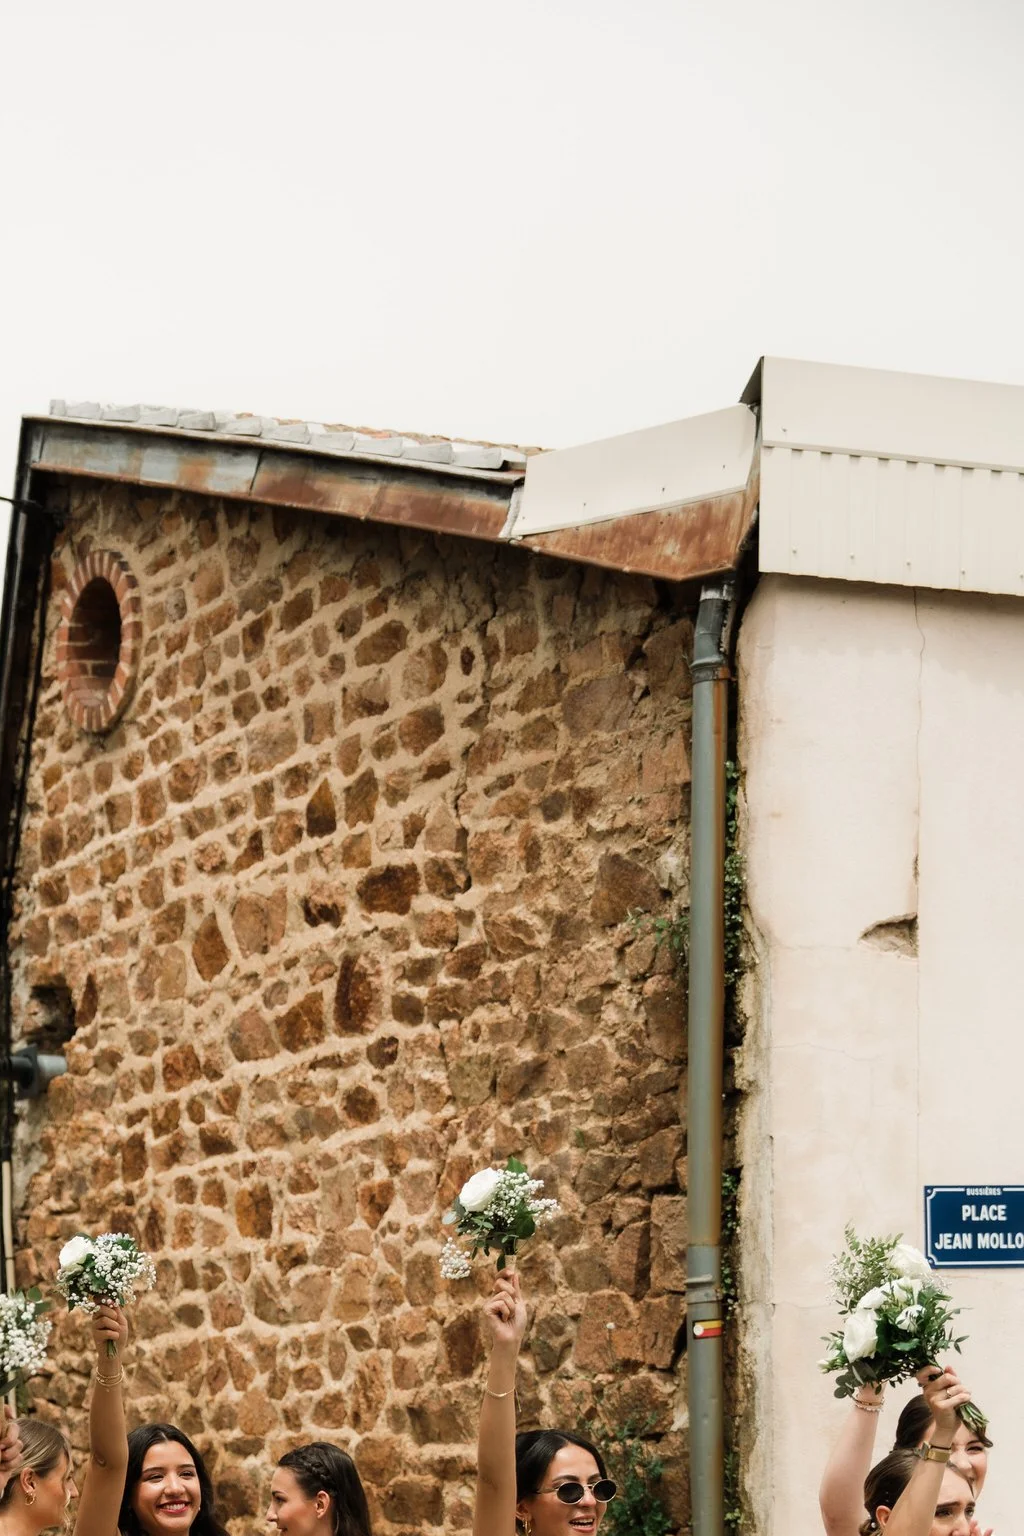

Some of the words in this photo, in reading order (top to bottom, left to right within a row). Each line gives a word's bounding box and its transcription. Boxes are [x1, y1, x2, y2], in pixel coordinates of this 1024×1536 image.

[966, 1186, 1002, 1196] BUSSIÈRES
[961, 1204, 1008, 1221] PLACE
[934, 1232, 972, 1250] JEAN
